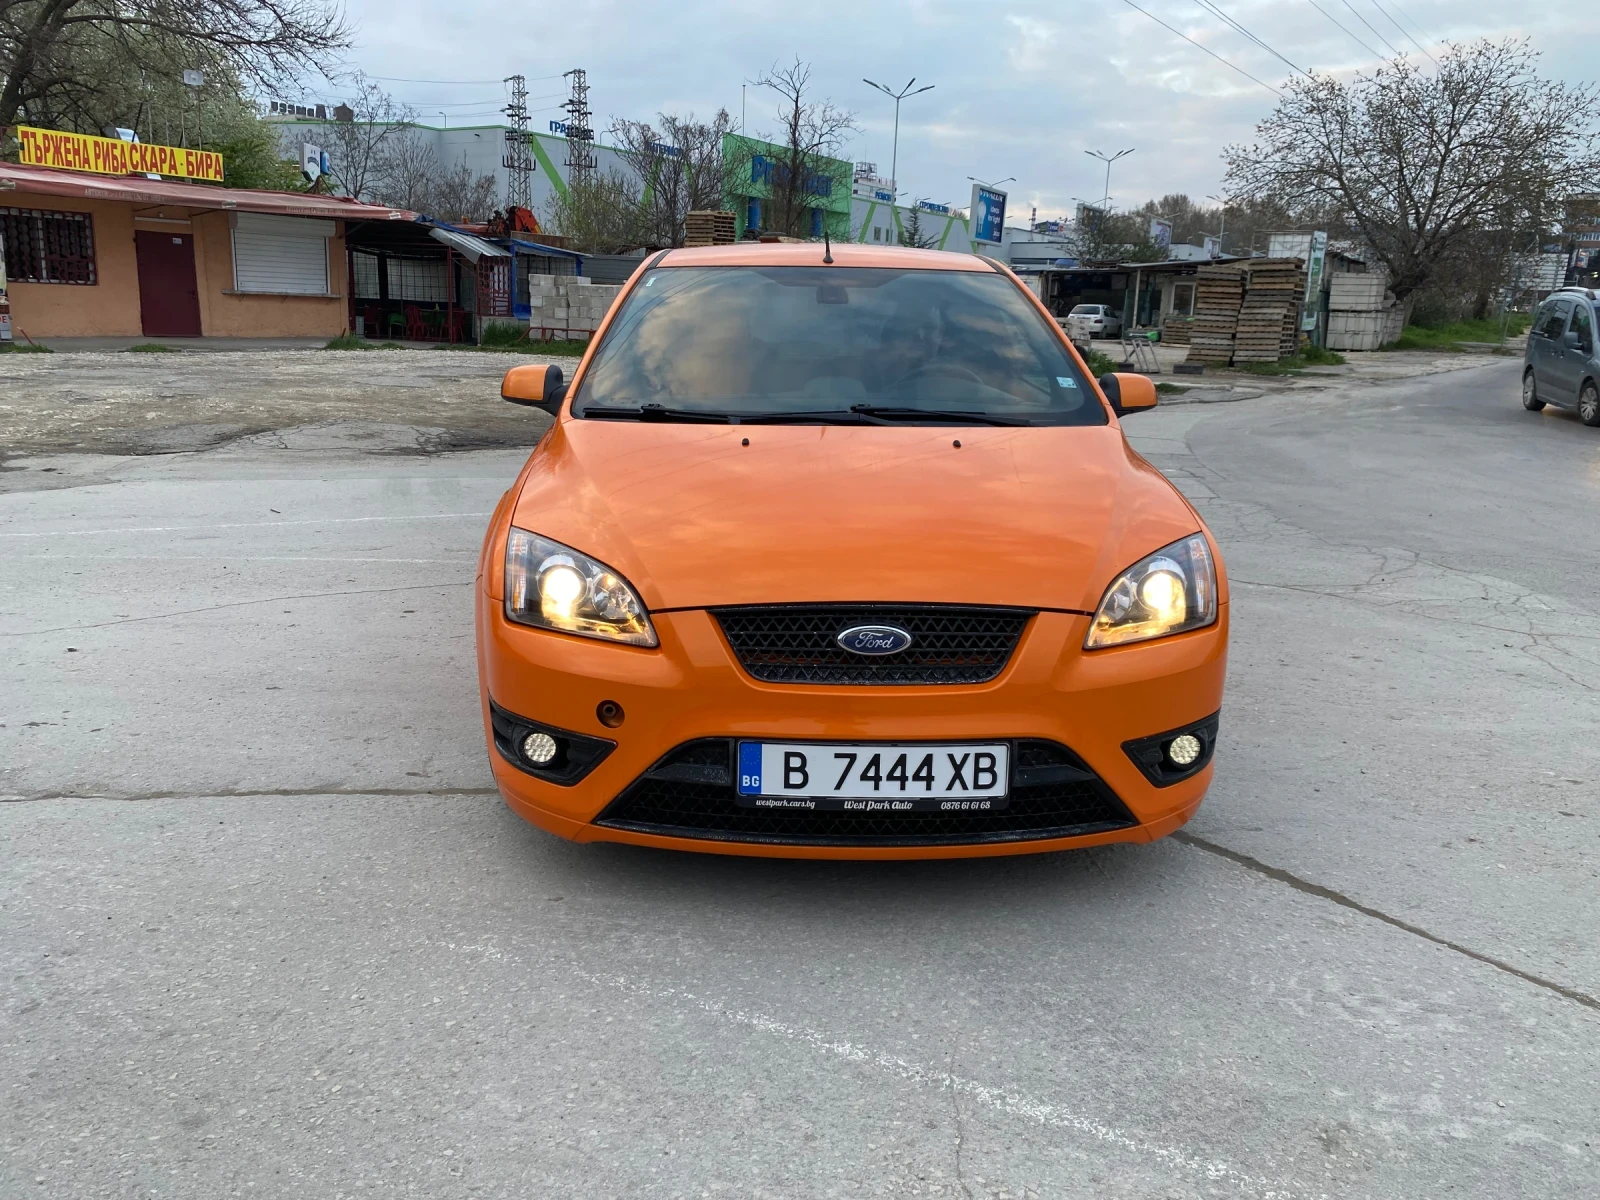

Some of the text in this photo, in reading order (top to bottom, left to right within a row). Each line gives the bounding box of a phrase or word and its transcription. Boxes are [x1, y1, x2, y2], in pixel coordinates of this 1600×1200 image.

[20, 130, 128, 174] ПЪРЖЕНА РИБА
[129, 143, 223, 180] СКАРА БИРА
[875, 191, 895, 202] РЕМОН
[855, 631, 894, 648] Ford
[783, 751, 809, 789] B
[833, 752, 935, 791] 7444
[742, 775, 760, 787] BG
[755, 799, 816, 810] westpark.cars.bg
[843, 800, 914, 811] West Park Auto
[940, 801, 991, 810] 0876 61 61 68
